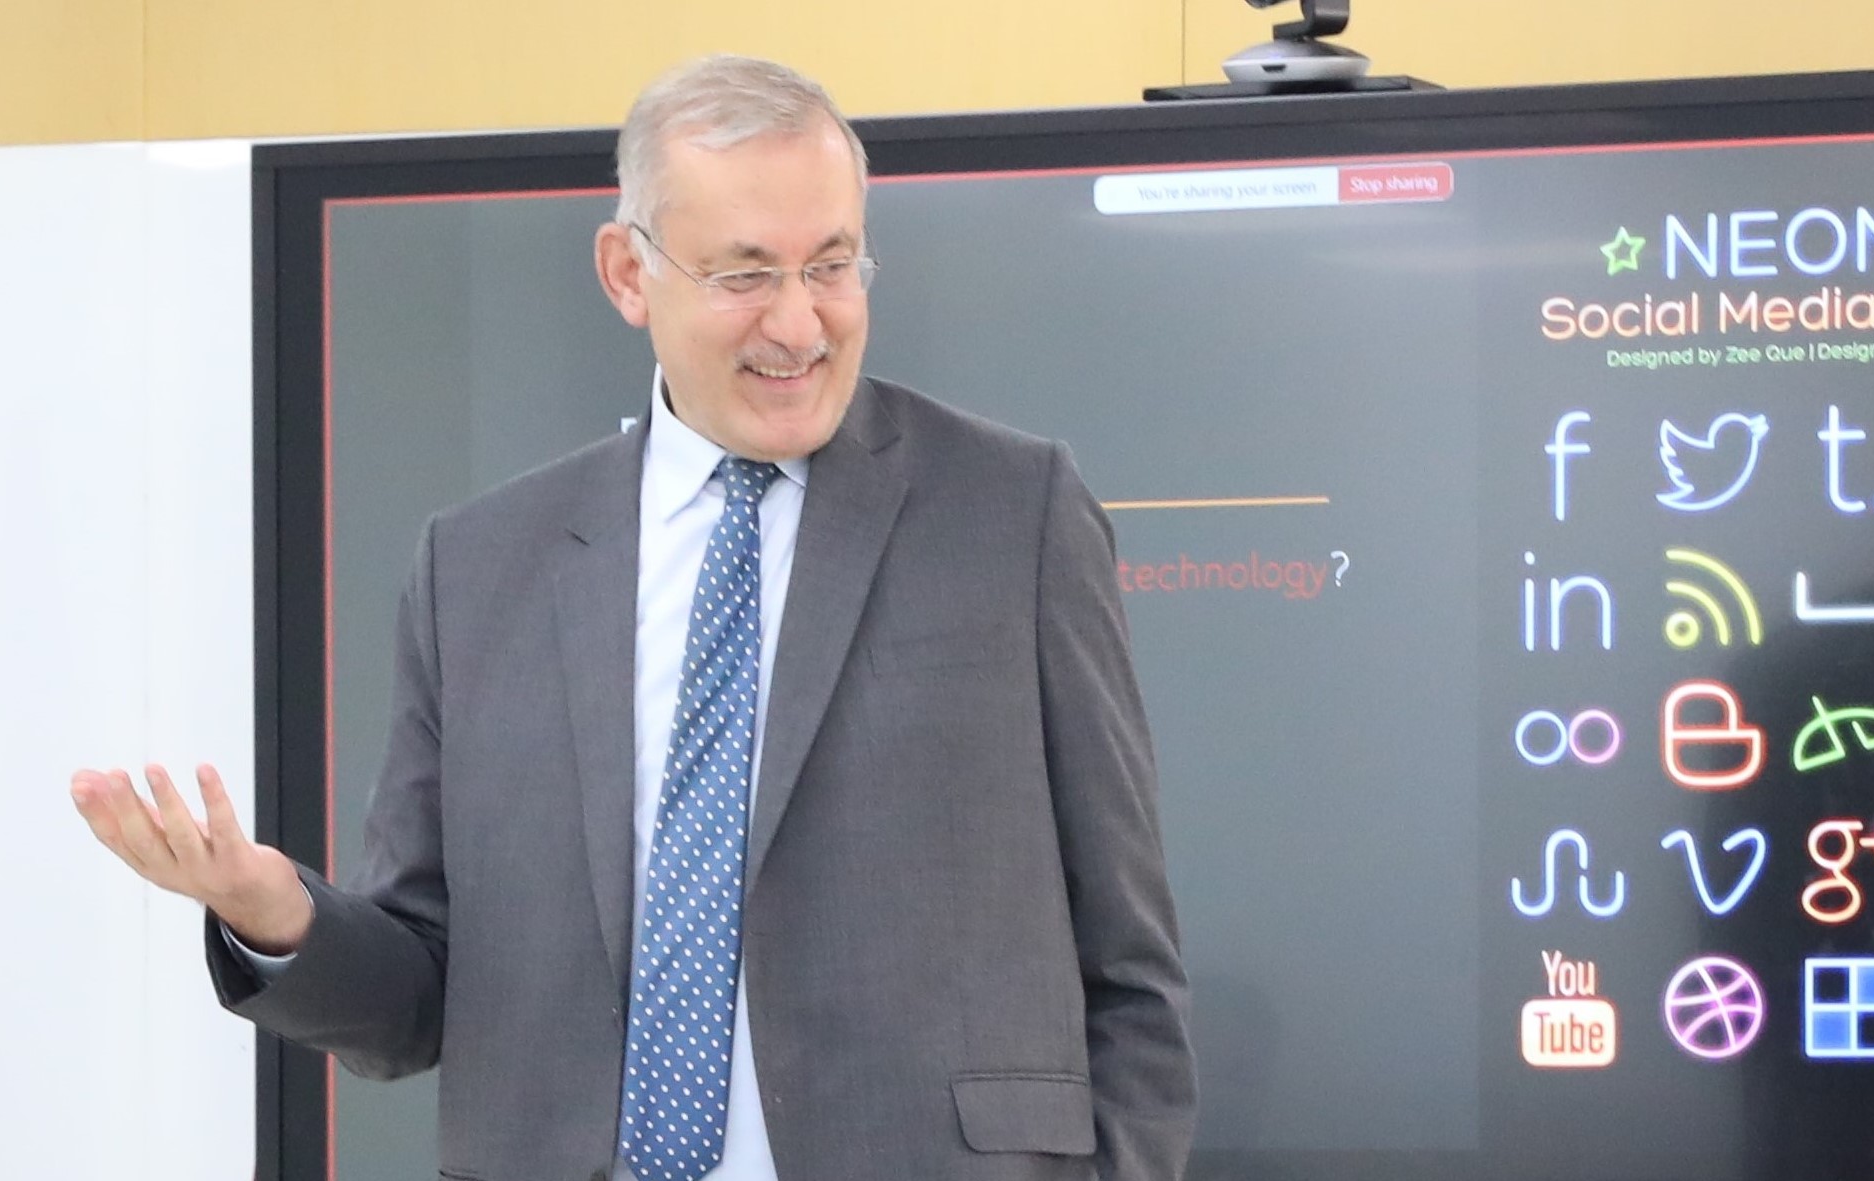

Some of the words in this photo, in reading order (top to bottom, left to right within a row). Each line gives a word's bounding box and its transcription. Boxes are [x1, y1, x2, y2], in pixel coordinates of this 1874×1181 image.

[1350, 176, 1383, 194] Stop
[1385, 174, 1438, 194] sharing
[1541, 289, 1701, 342] Social
[1606, 348, 1694, 370] Designed
[1698, 347, 1722, 367] by
[1726, 345, 1761, 363] Zee
[1765, 343, 1806, 362] Que
[1545, 411, 1592, 521] f
[1118, 550, 1351, 599] technology?
[1521, 552, 1614, 652] in
[1542, 951, 1596, 997] You
[1535, 1012, 1606, 1053] Tube
